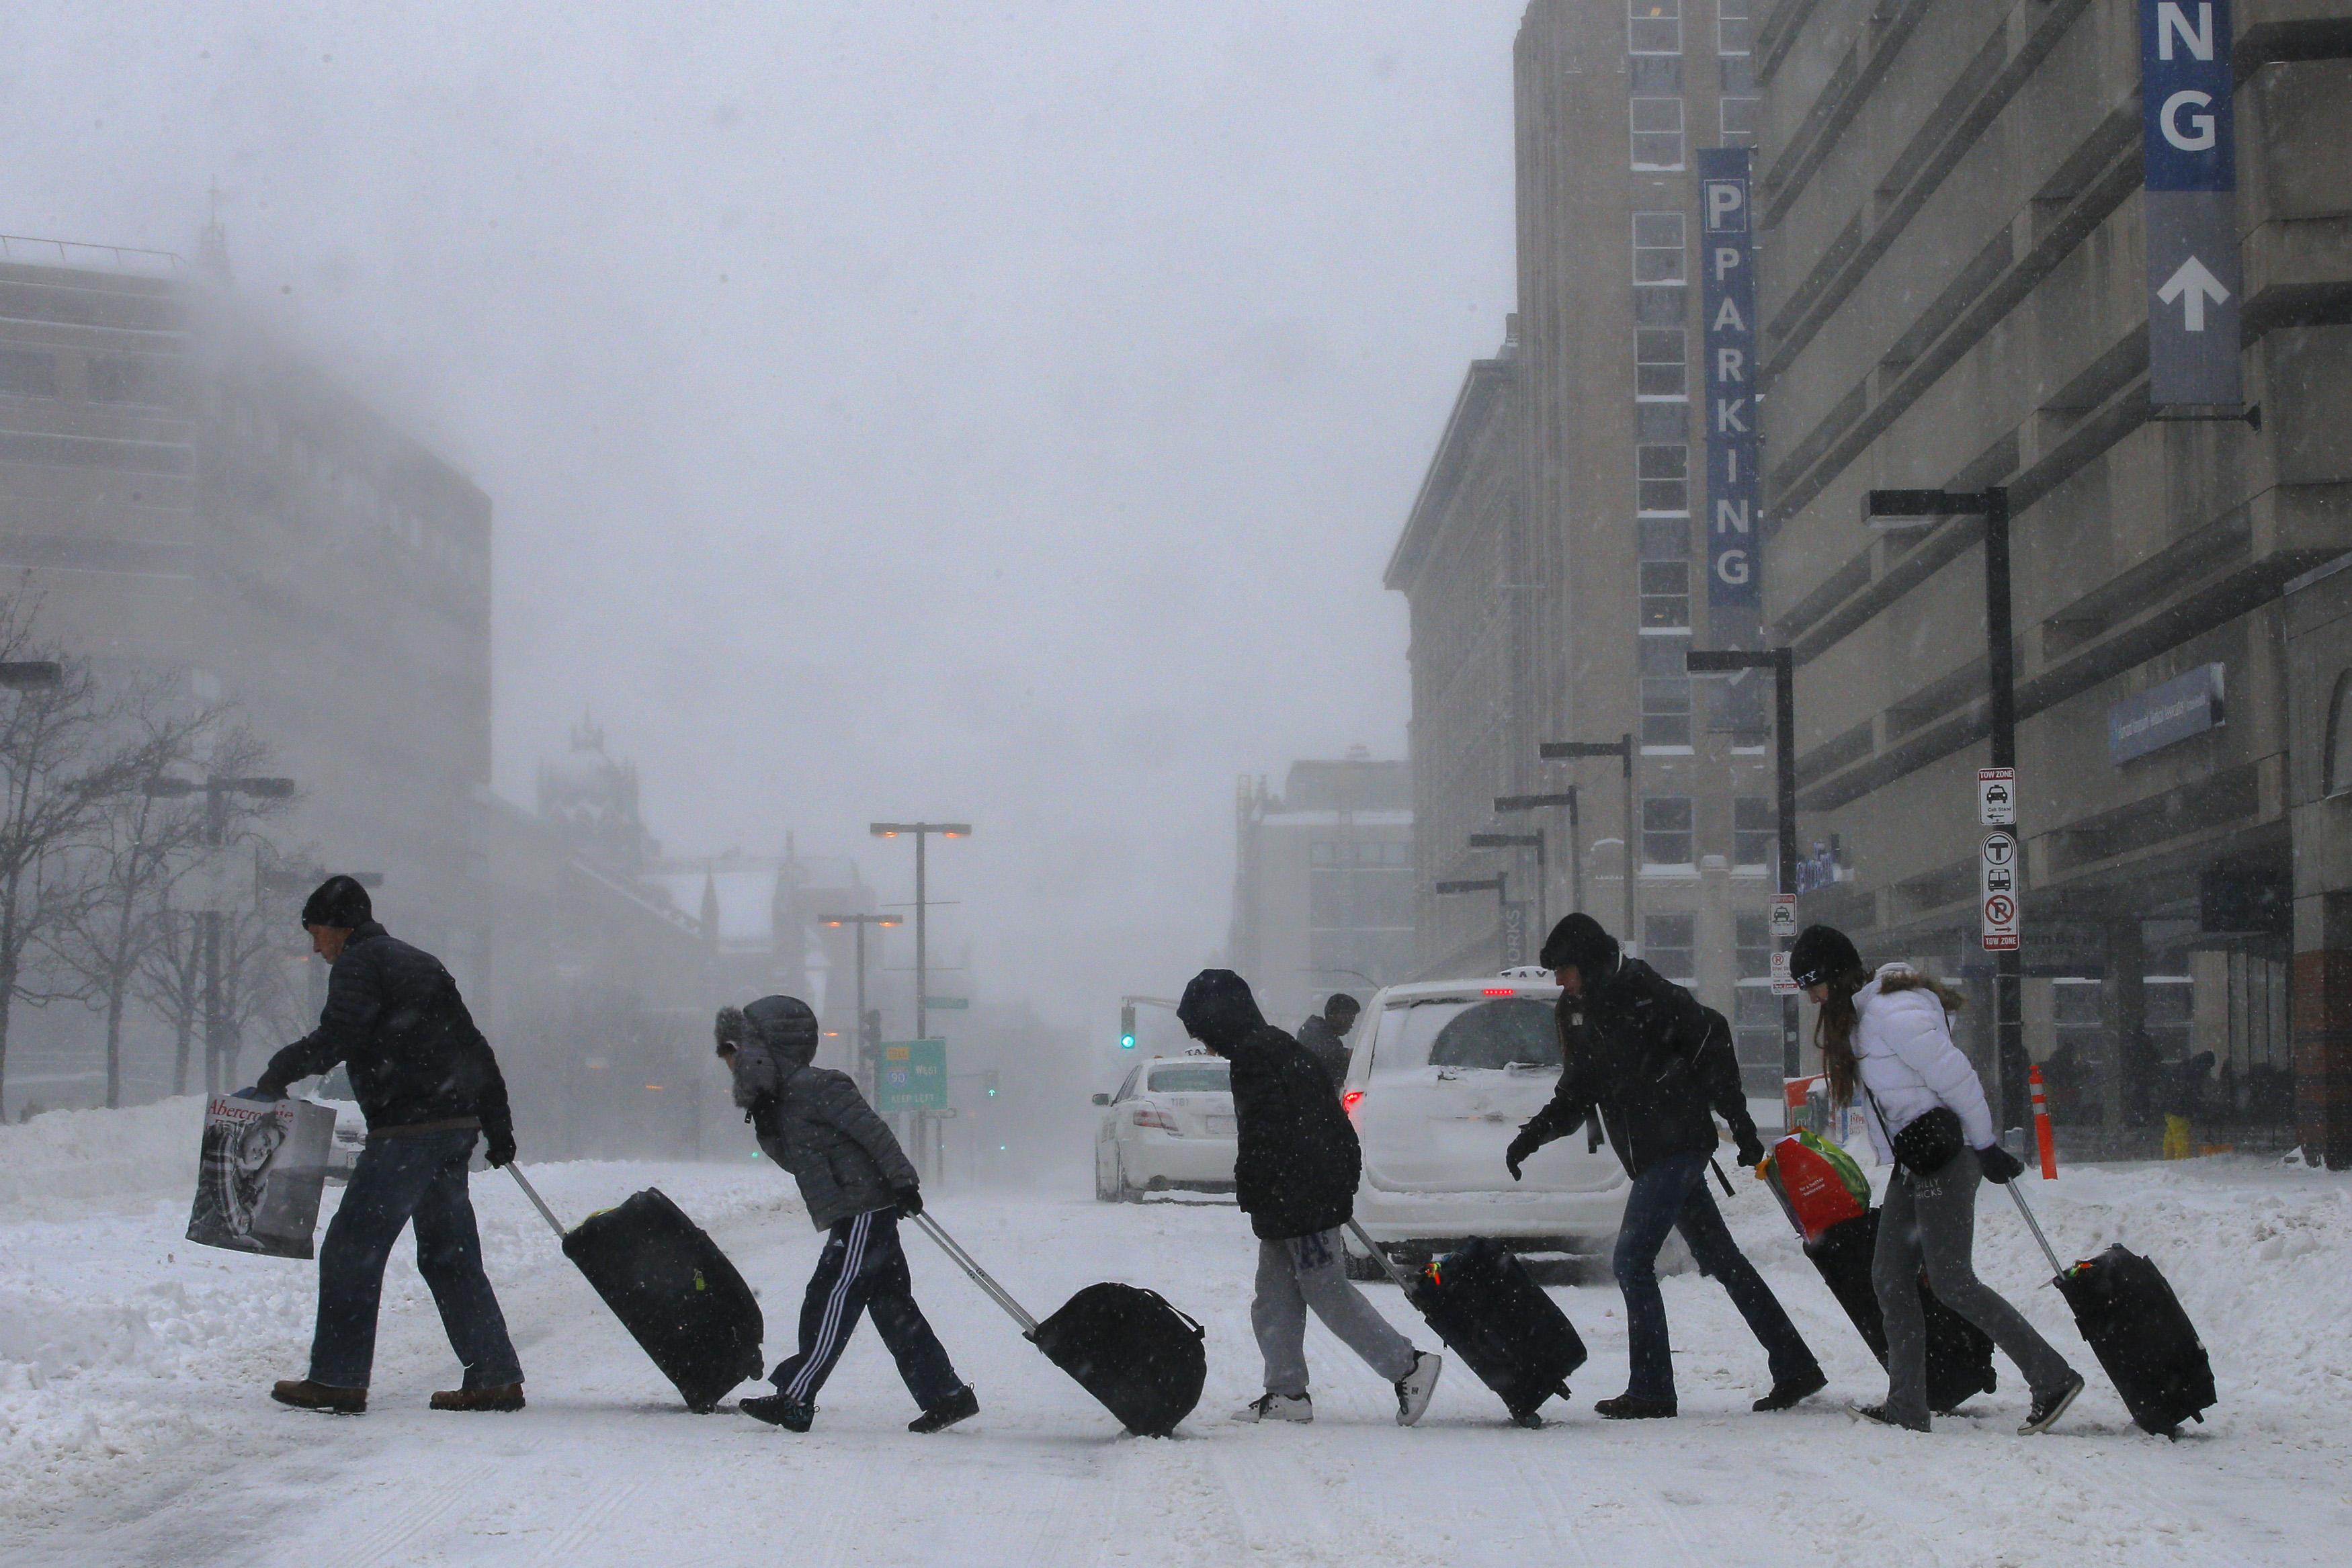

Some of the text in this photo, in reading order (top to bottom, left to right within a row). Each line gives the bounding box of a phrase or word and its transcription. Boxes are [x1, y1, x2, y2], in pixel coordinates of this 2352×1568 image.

[1708, 185, 1742, 228] P
[1713, 247, 1749, 584] PARKING
[1996, 770, 2013, 778] ZONE
[1988, 842, 2009, 861] T
[2001, 937, 2017, 945] ZONE
[915, 1065, 937, 1075] WEST
[891, 1072, 906, 1084] 90
[891, 1094, 935, 1103] KEEP LEFT
